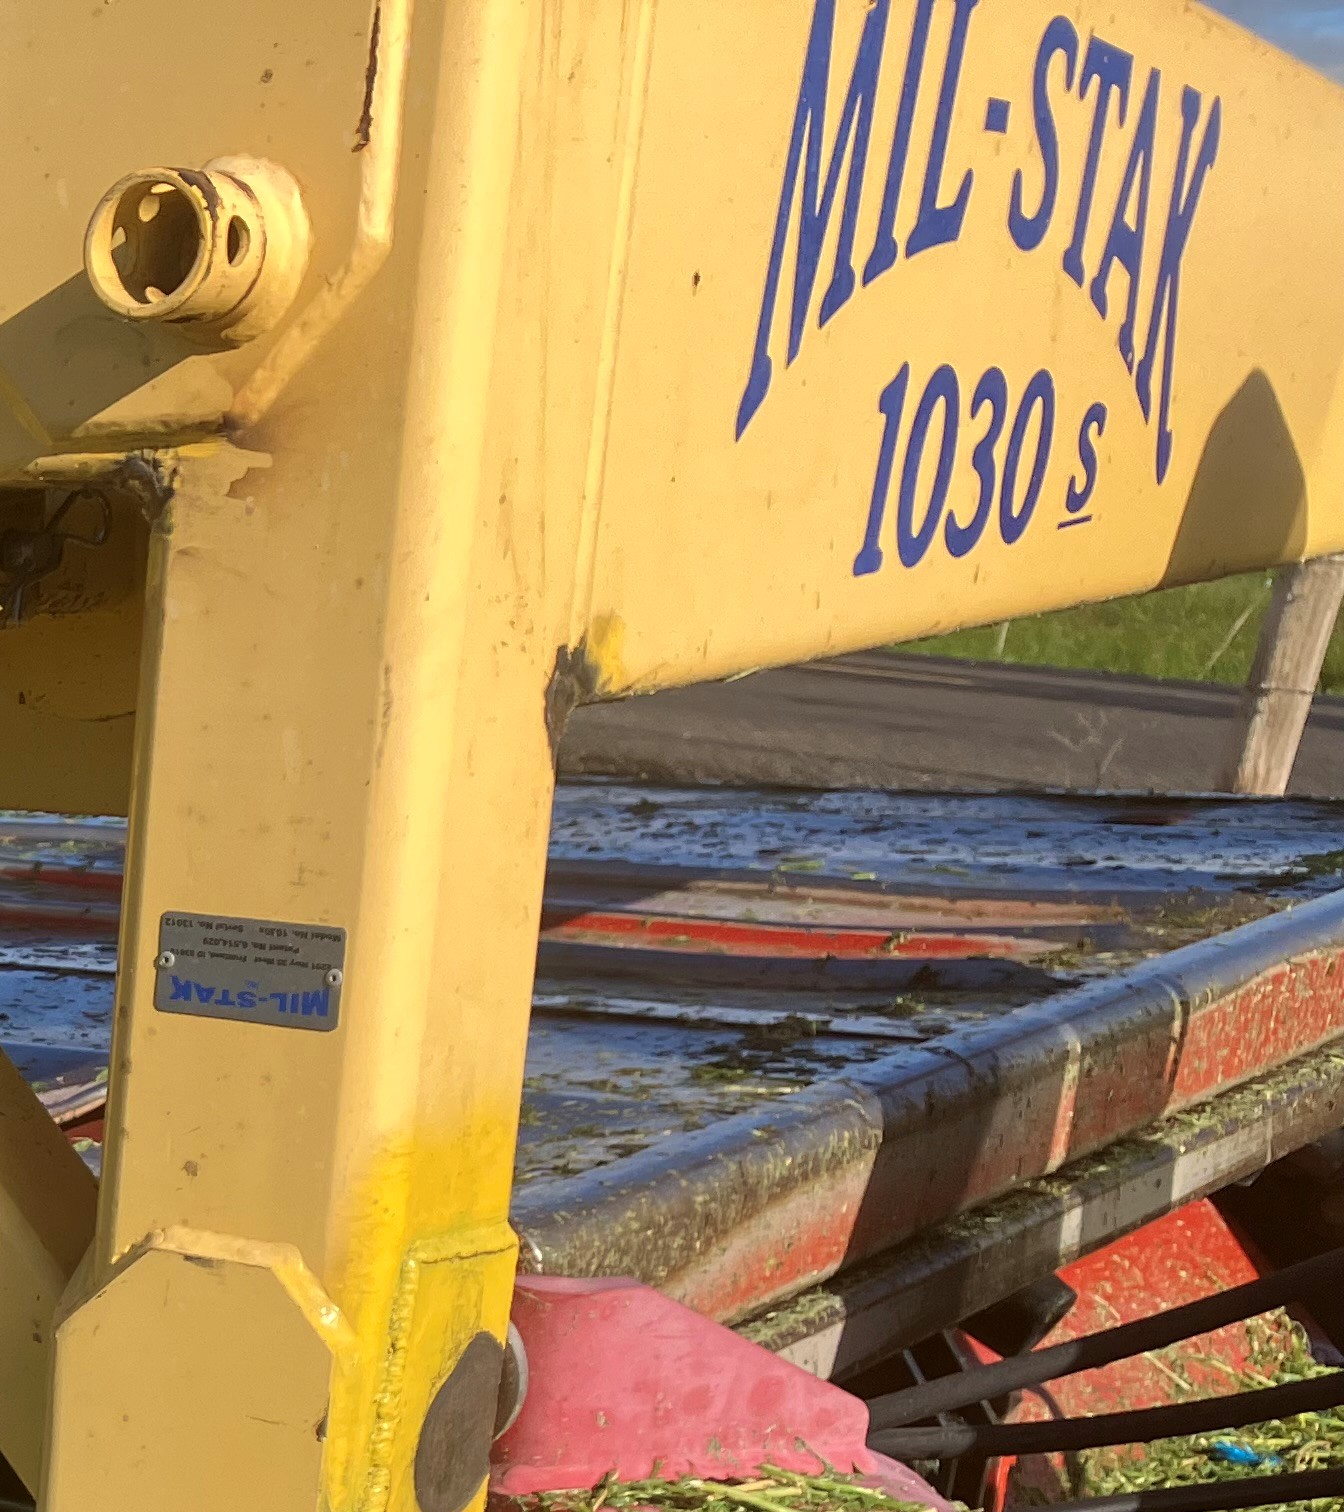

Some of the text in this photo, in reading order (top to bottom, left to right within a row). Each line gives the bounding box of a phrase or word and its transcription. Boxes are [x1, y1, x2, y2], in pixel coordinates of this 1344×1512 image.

[735, 0, 1222, 485] MIL-STAK
[853, 361, 1055, 577] 1030
[170, 975, 329, 1016] MIL-STAK
